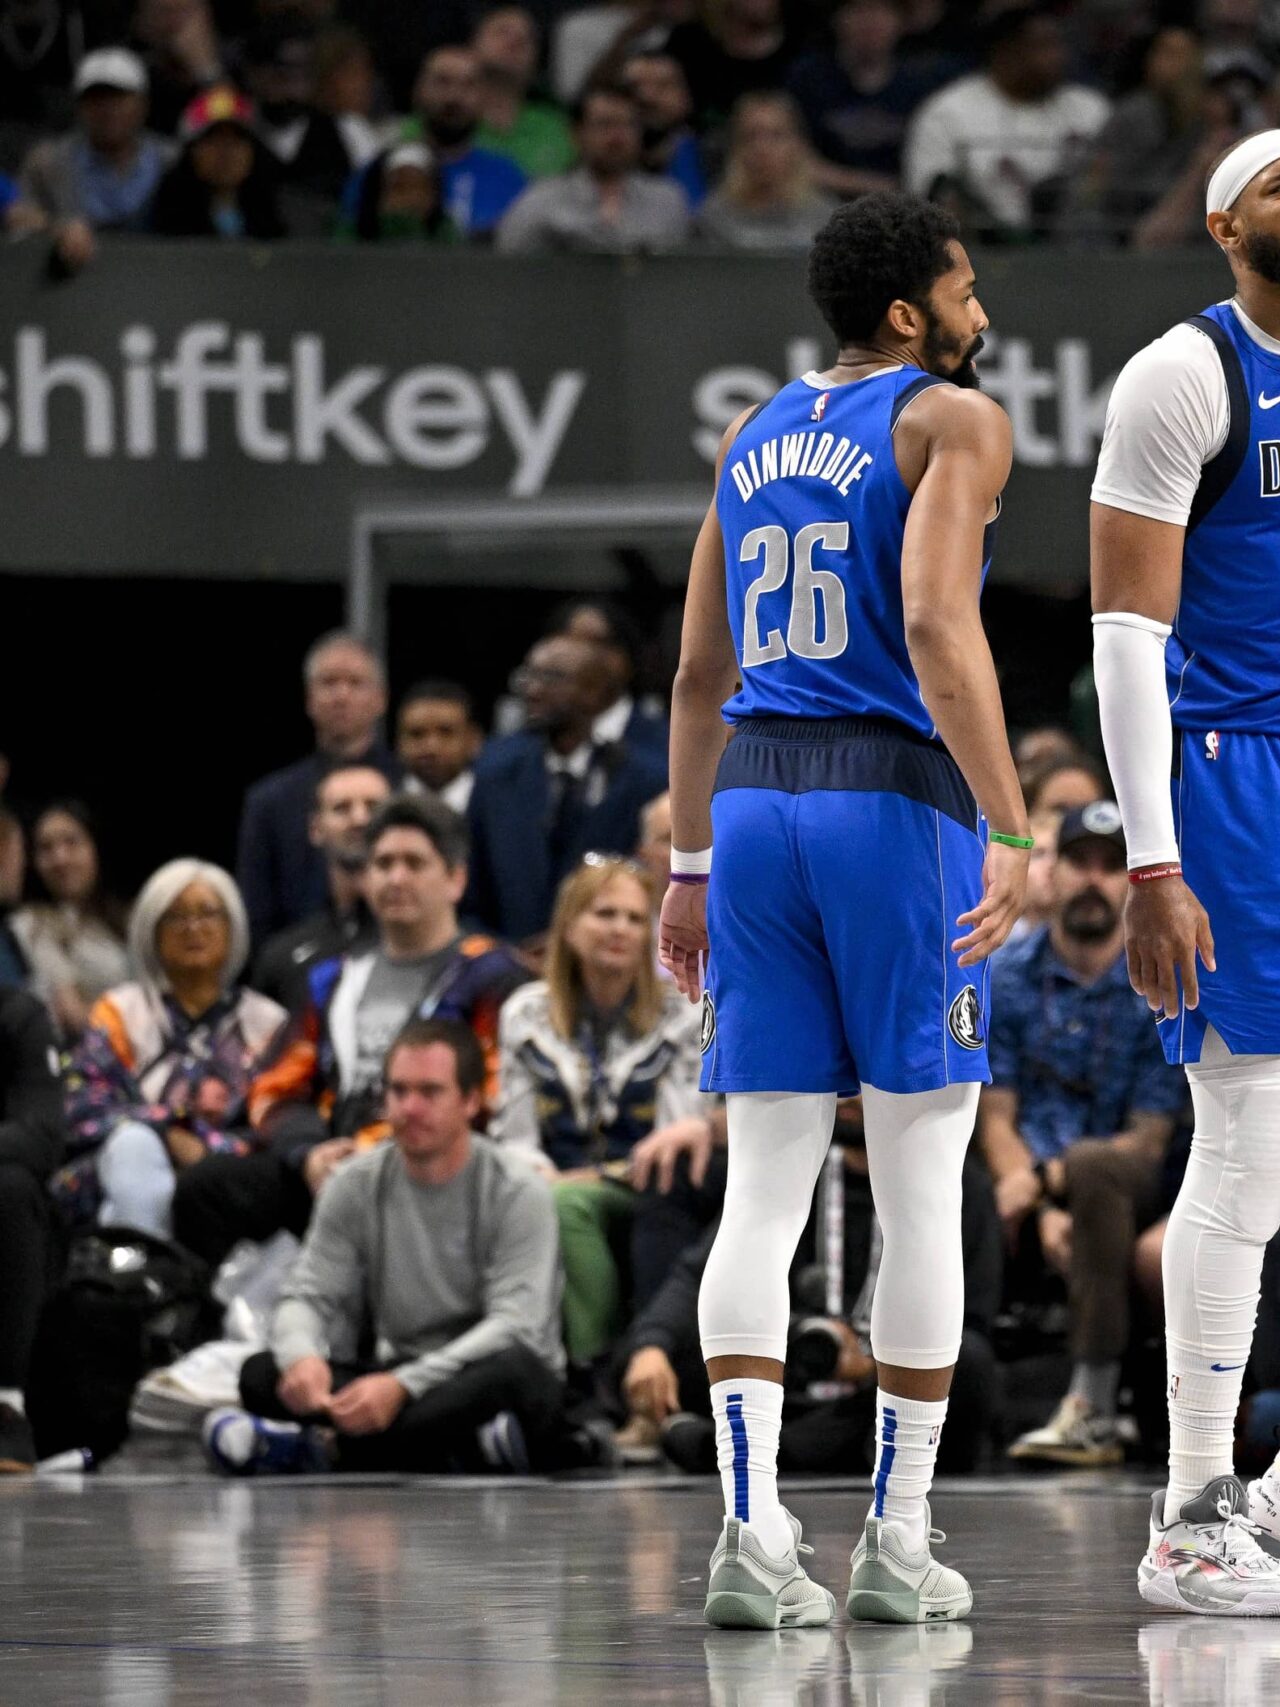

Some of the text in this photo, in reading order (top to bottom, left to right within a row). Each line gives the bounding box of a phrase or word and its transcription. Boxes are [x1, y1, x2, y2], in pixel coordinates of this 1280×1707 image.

[0, 319, 587, 498] hiftkey
[731, 432, 873, 503] DINWIDDIE
[740, 521, 850, 668] 26
